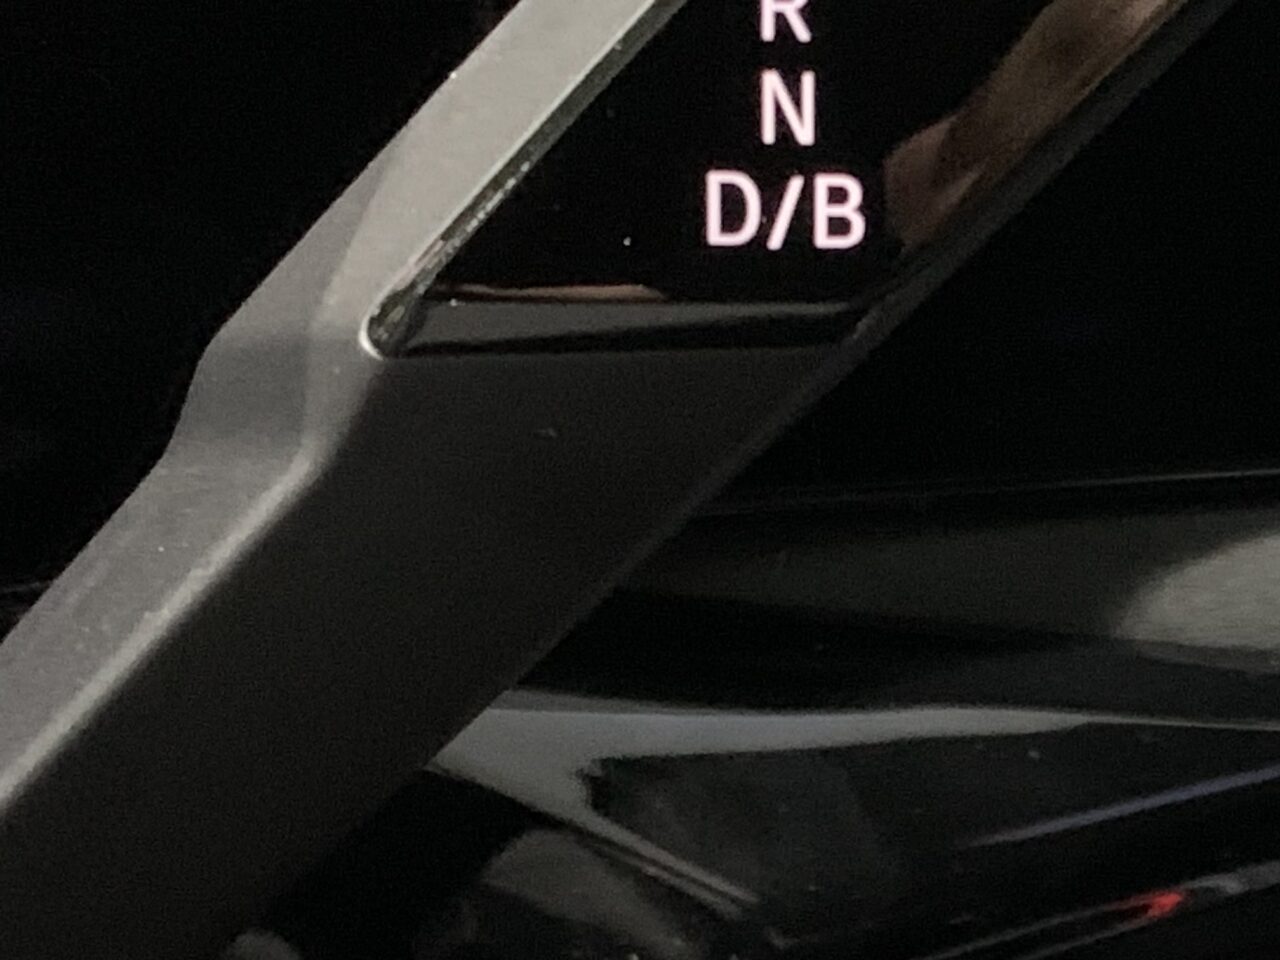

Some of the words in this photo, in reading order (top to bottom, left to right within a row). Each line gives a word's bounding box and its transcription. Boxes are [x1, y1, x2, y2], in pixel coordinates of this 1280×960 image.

[760, 0, 812, 42] R
[761, 68, 816, 146] N
[705, 169, 866, 250] D/B
